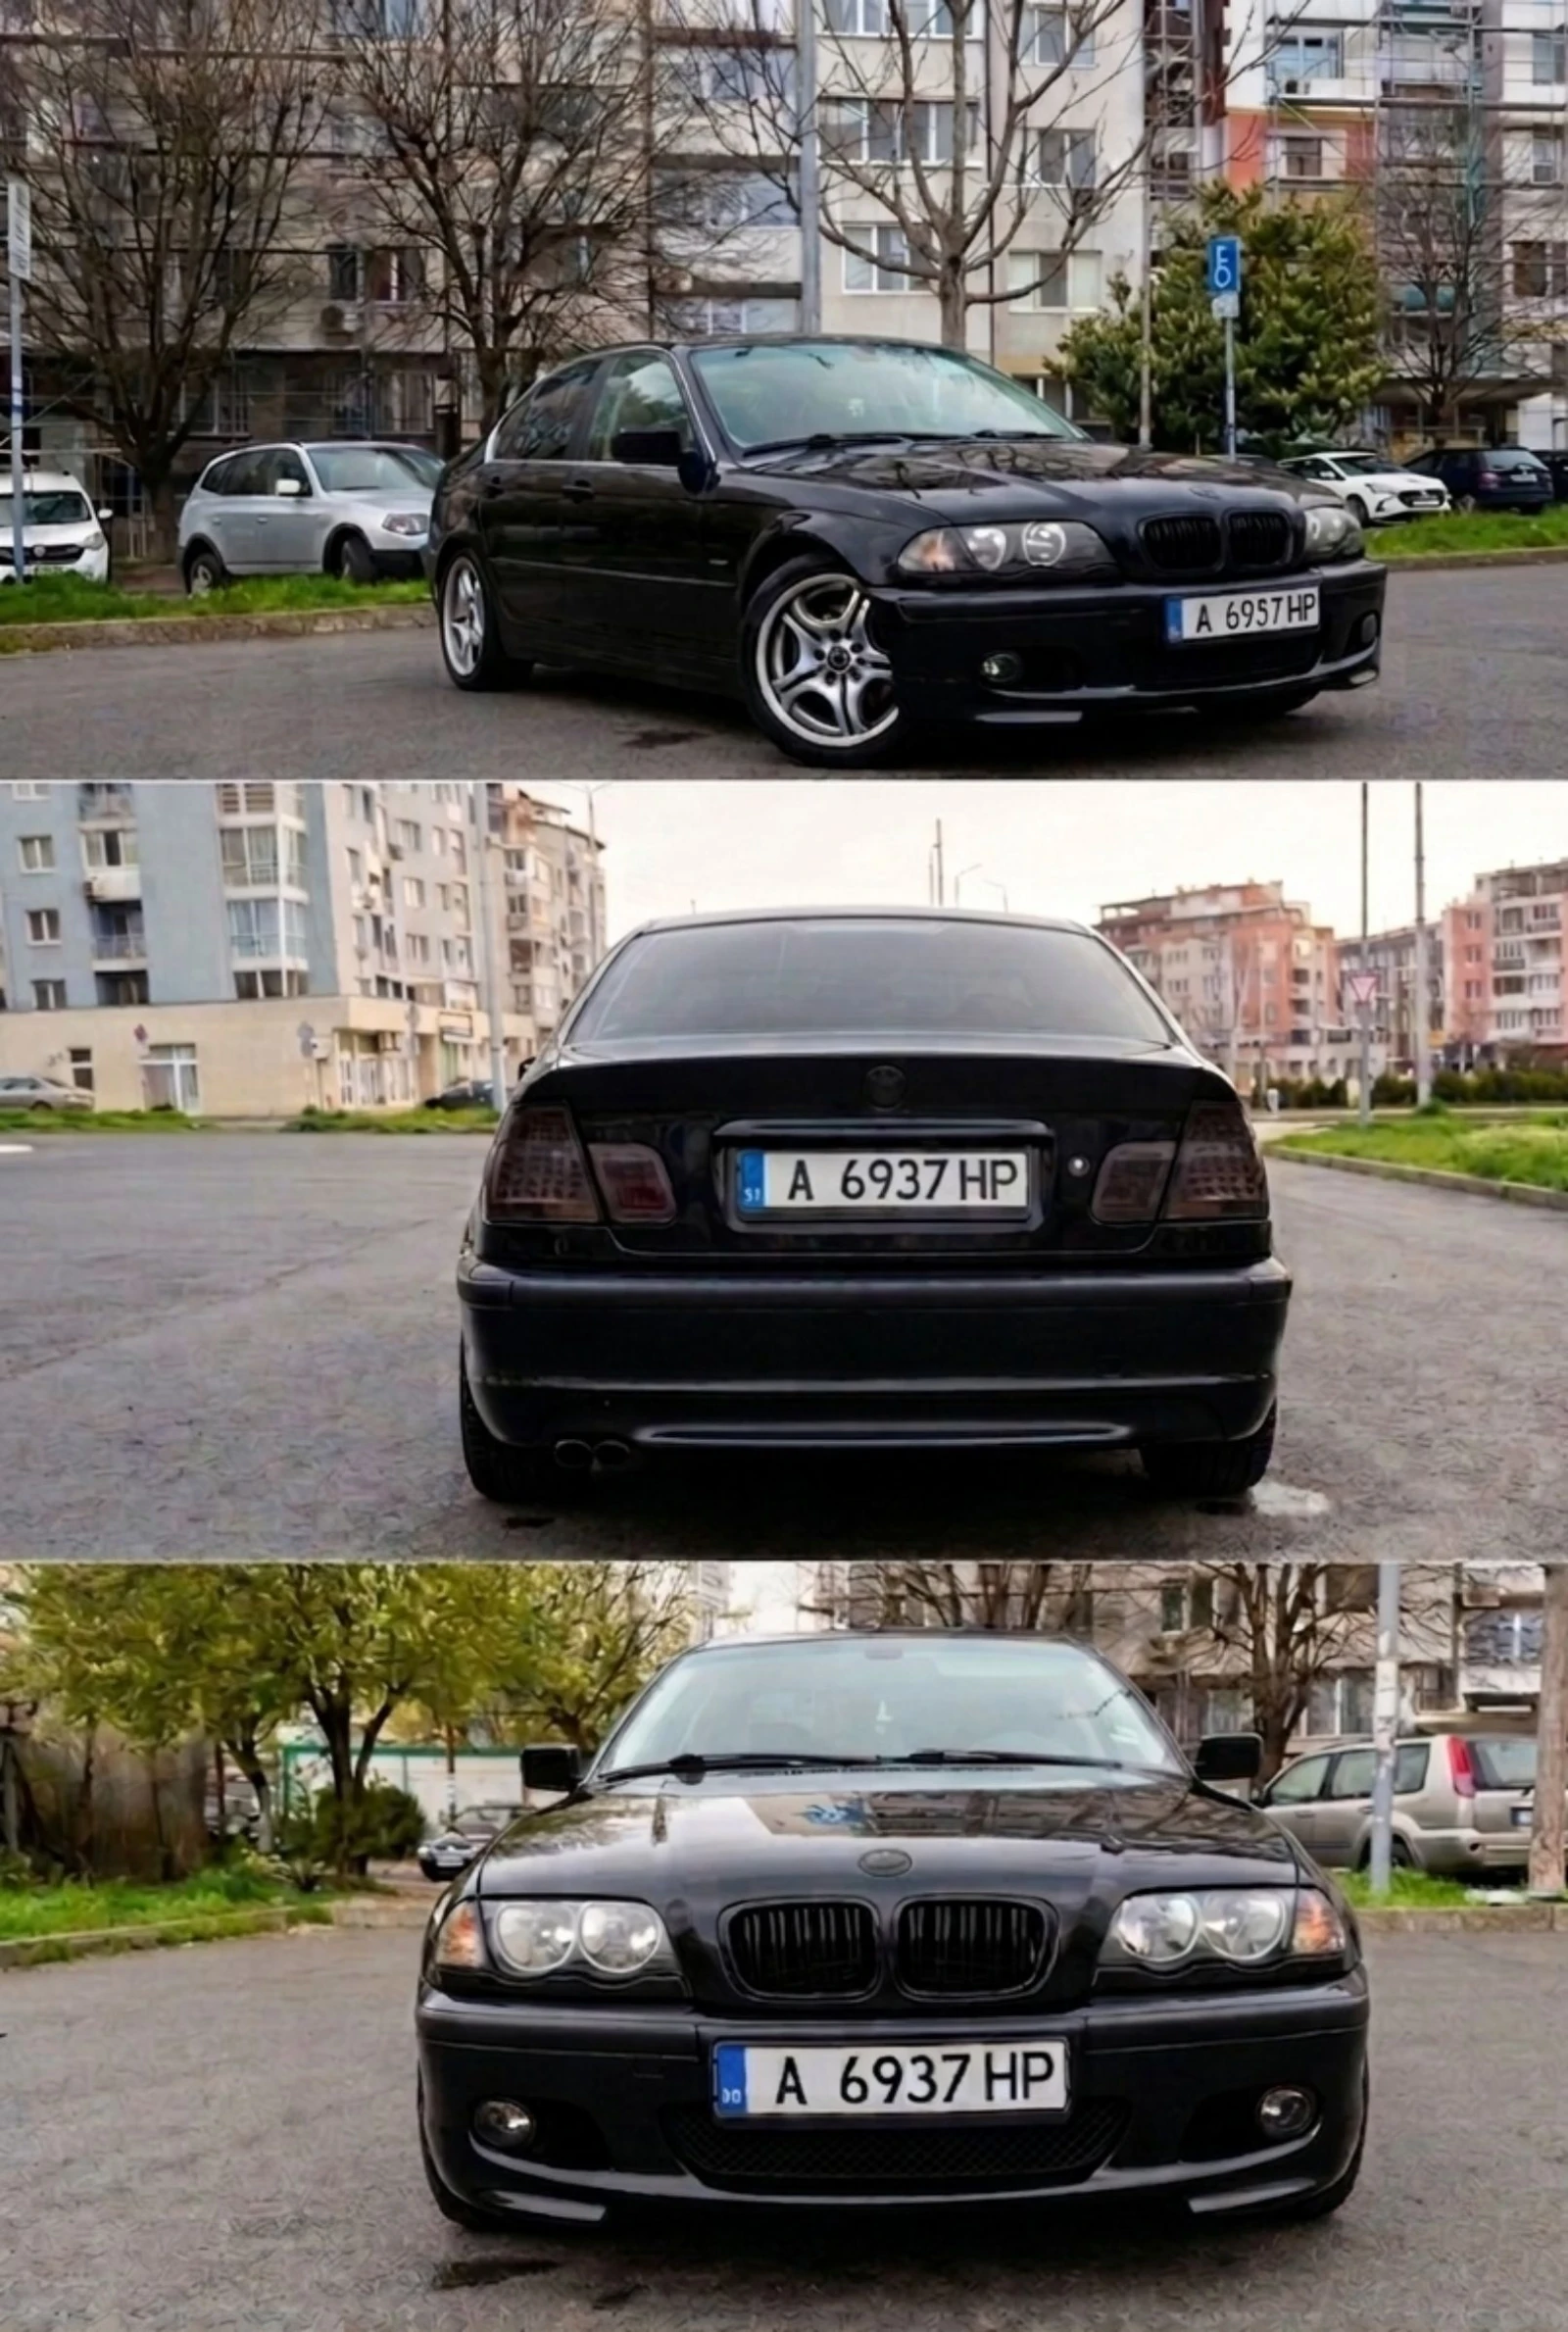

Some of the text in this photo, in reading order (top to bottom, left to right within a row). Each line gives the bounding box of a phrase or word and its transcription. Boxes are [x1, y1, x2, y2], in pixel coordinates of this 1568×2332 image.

[1196, 604, 1212, 633] A
[1287, 593, 1316, 622] HP
[787, 1159, 814, 1201] A
[841, 1159, 949, 1200] 6937
[959, 1159, 1018, 1201] HP
[775, 2056, 808, 2106] A
[840, 2054, 971, 2105] 6937
[985, 2052, 1054, 2102] HP
